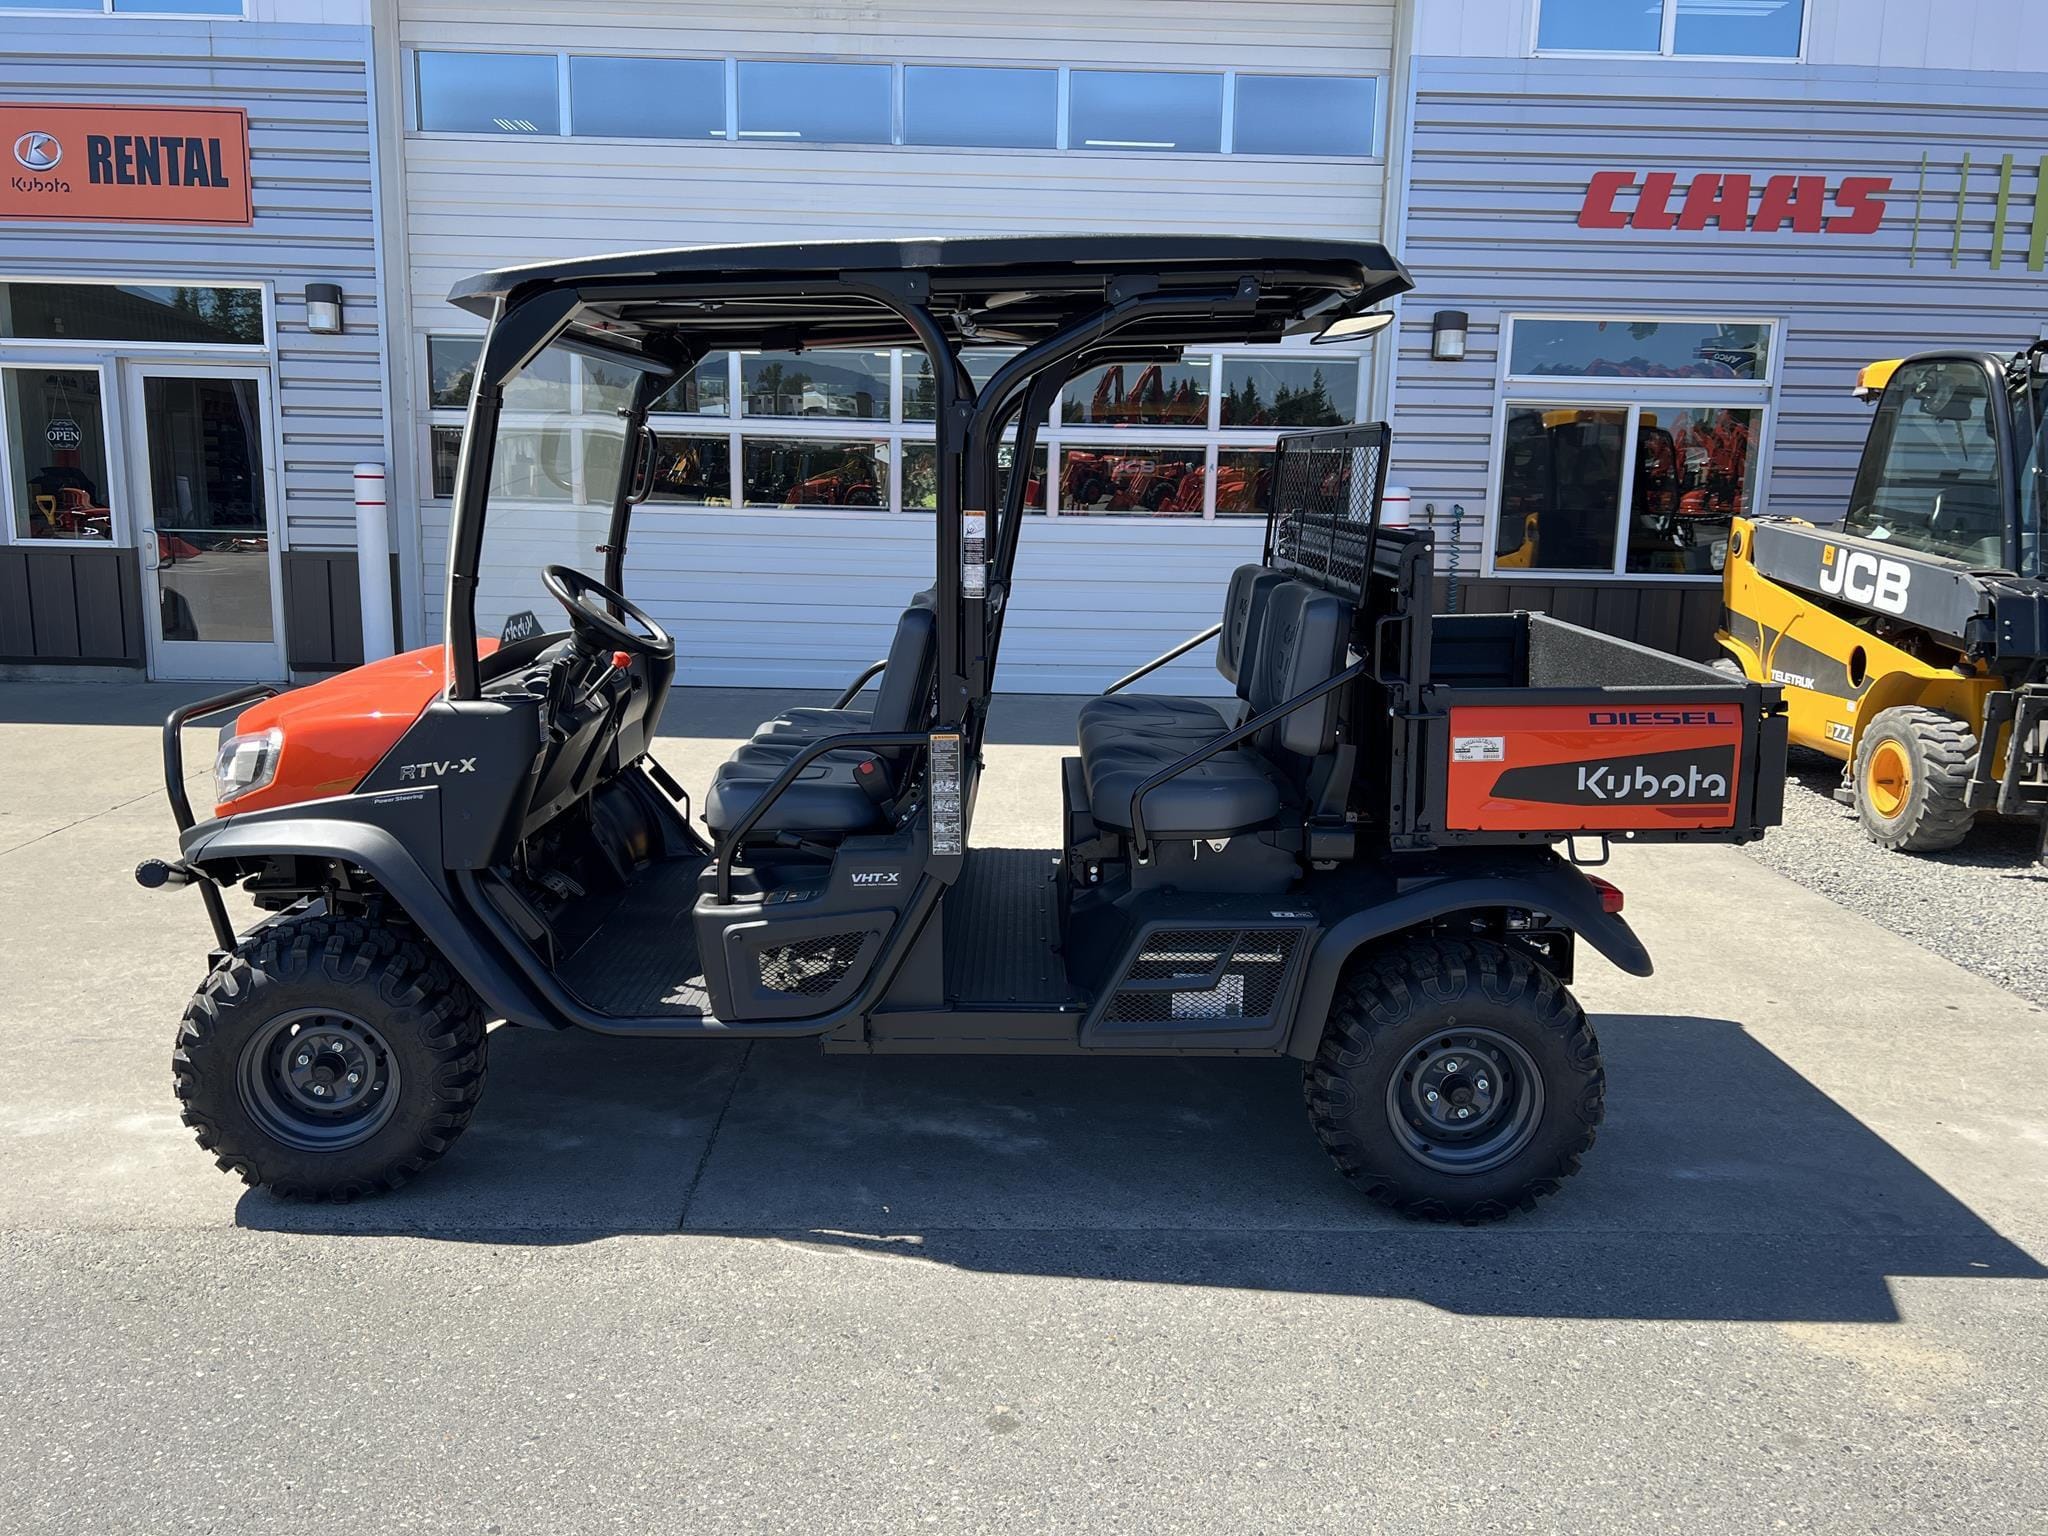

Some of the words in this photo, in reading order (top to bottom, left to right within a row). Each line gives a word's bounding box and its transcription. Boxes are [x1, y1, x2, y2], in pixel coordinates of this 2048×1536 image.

[87, 134, 229, 188] RENTAL
[11, 176, 70, 193] Kubota
[1577, 171, 1892, 235] CLAAS
[47, 431, 79, 441] OPEN
[1819, 548, 1911, 615] JCB
[1771, 669, 1815, 690] TELETRUK
[1589, 712, 1733, 725] DIESEL
[399, 757, 477, 781] RTV-X
[1577, 765, 1726, 799] Kubota
[851, 872, 900, 883] VHT-X
